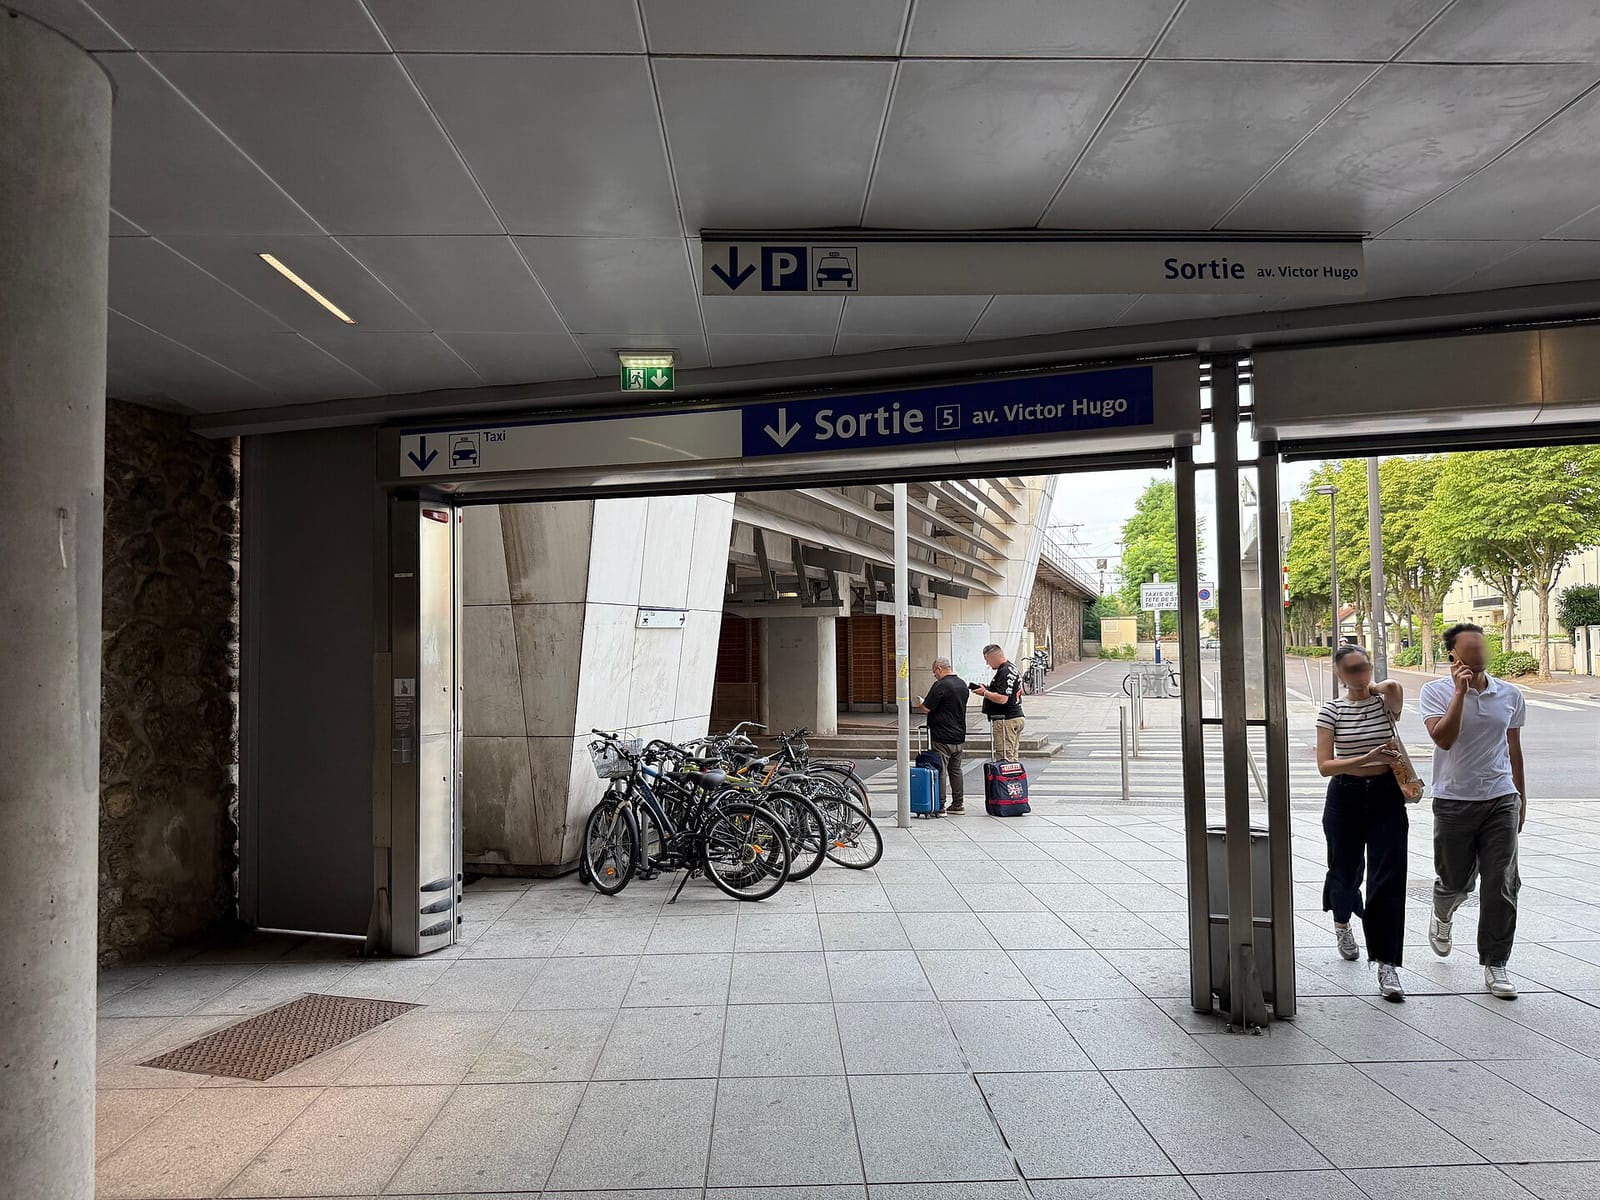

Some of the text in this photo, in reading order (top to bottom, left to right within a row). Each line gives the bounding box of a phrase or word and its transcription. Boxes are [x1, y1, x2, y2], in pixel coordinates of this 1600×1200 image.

[771, 252, 798, 287] P
[1164, 257, 1359, 281] Sortie av. Victor Hugo
[815, 397, 1128, 440] Sortie 5 av. Victor Hugo
[483, 430, 506, 442] Taxi
